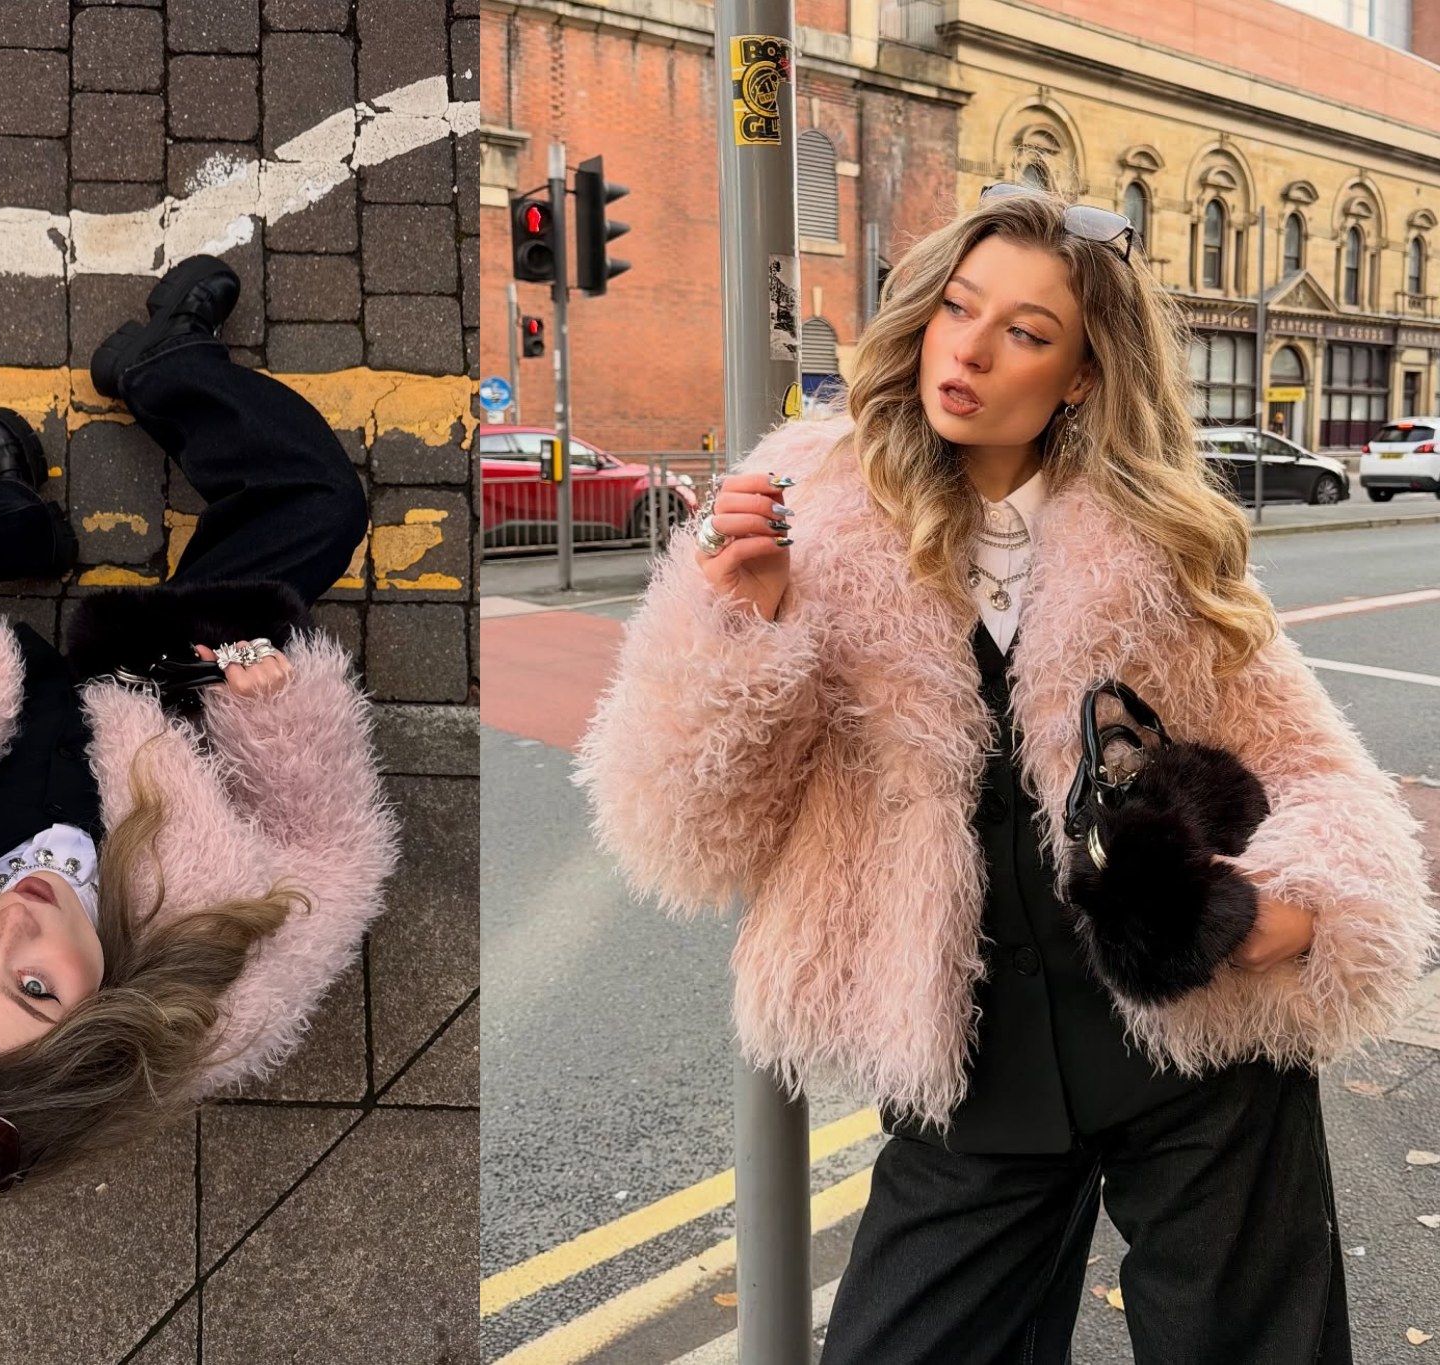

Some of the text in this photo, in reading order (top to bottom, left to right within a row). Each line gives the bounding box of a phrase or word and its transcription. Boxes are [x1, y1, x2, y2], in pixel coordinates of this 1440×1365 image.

[1186, 312, 1249, 328] SHIPPING
[1271, 319, 1323, 334] CARTAGE
[1350, 327, 1384, 340] GOODS
